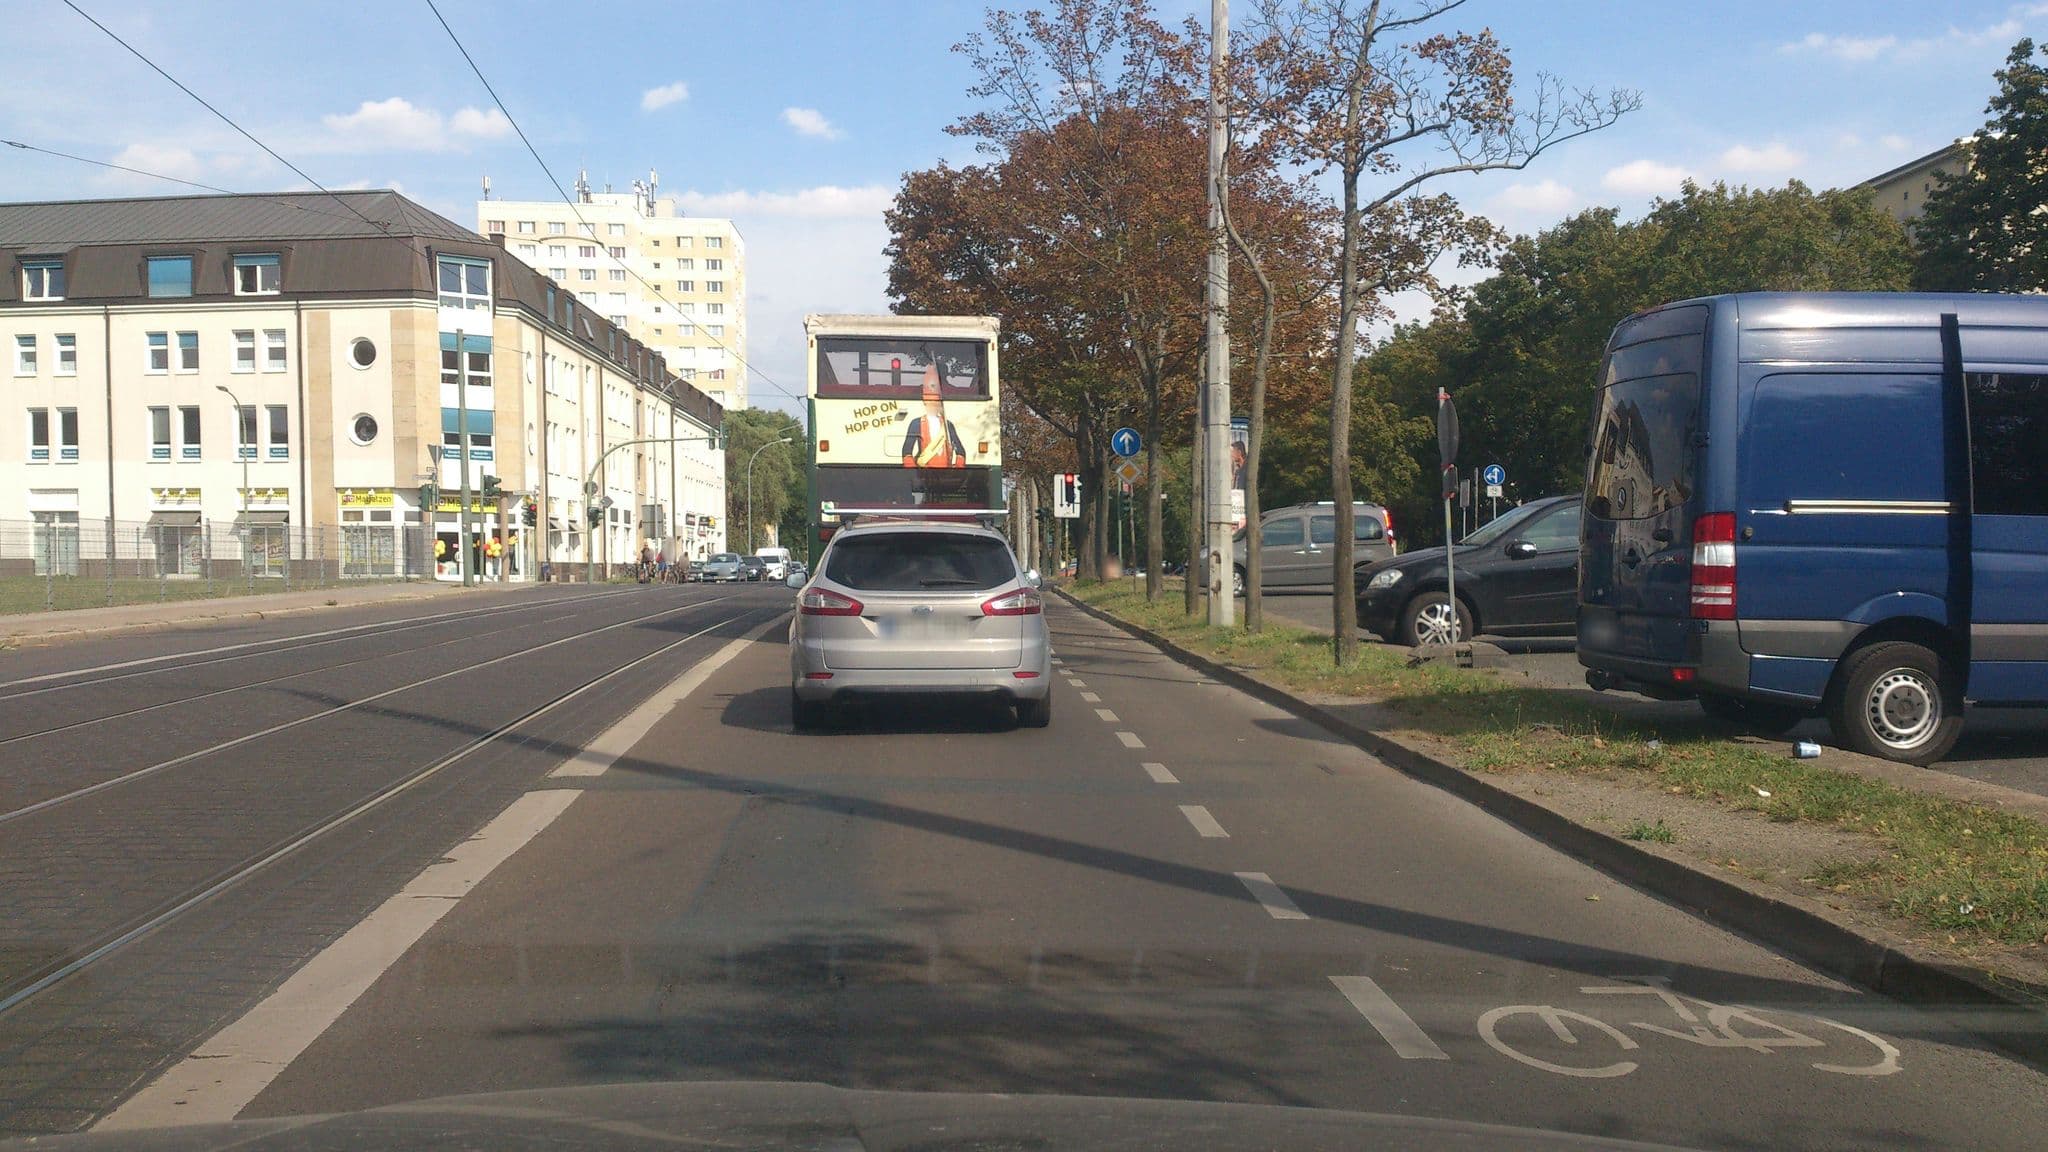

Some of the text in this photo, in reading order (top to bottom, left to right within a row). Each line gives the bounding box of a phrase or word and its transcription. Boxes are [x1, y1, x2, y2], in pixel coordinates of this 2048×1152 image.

[853, 400, 898, 418] HOP ON
[845, 415, 893, 434] HOP OFF
